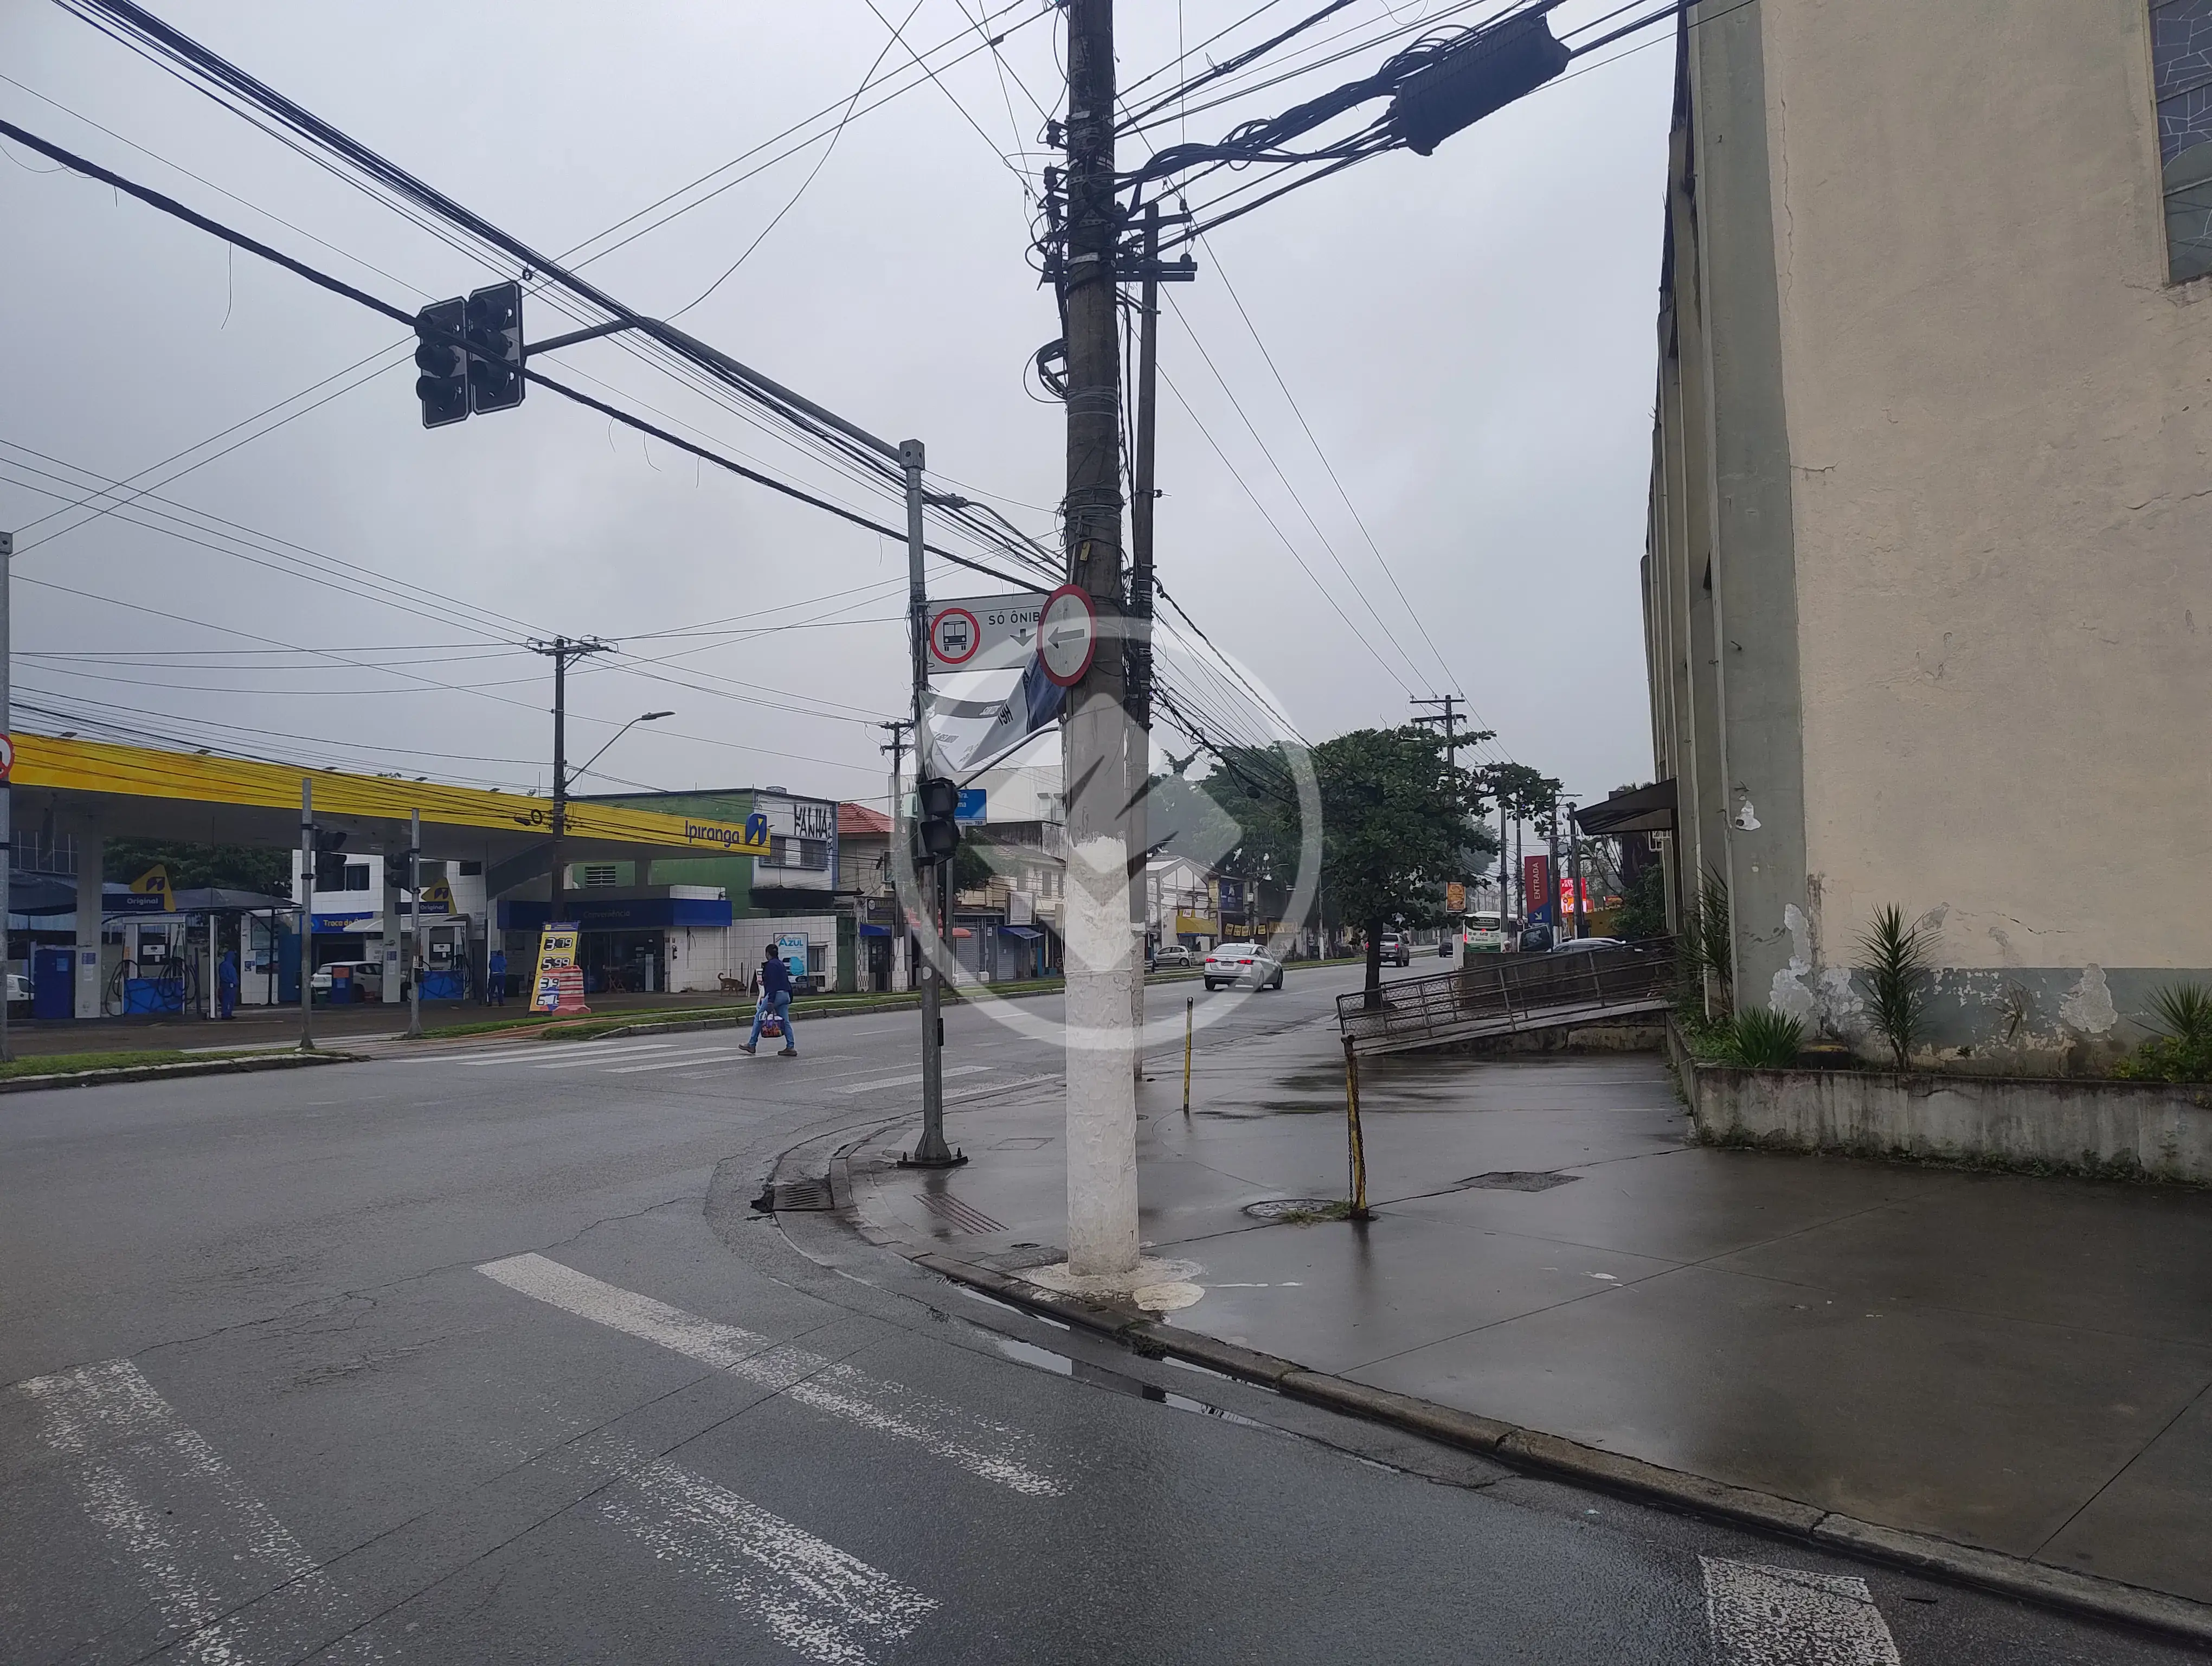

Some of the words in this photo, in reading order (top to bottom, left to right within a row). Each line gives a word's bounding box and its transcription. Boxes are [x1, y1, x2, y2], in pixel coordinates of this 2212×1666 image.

[988, 611, 1005, 625] SÓ
[1010, 610, 1040, 624] ÔNIB
[685, 820, 740, 848] Ipiranga
[1532, 862, 1540, 899] ENTRADA
[583, 909, 631, 919] Conveniência
[779, 937, 803, 947] AZUL
